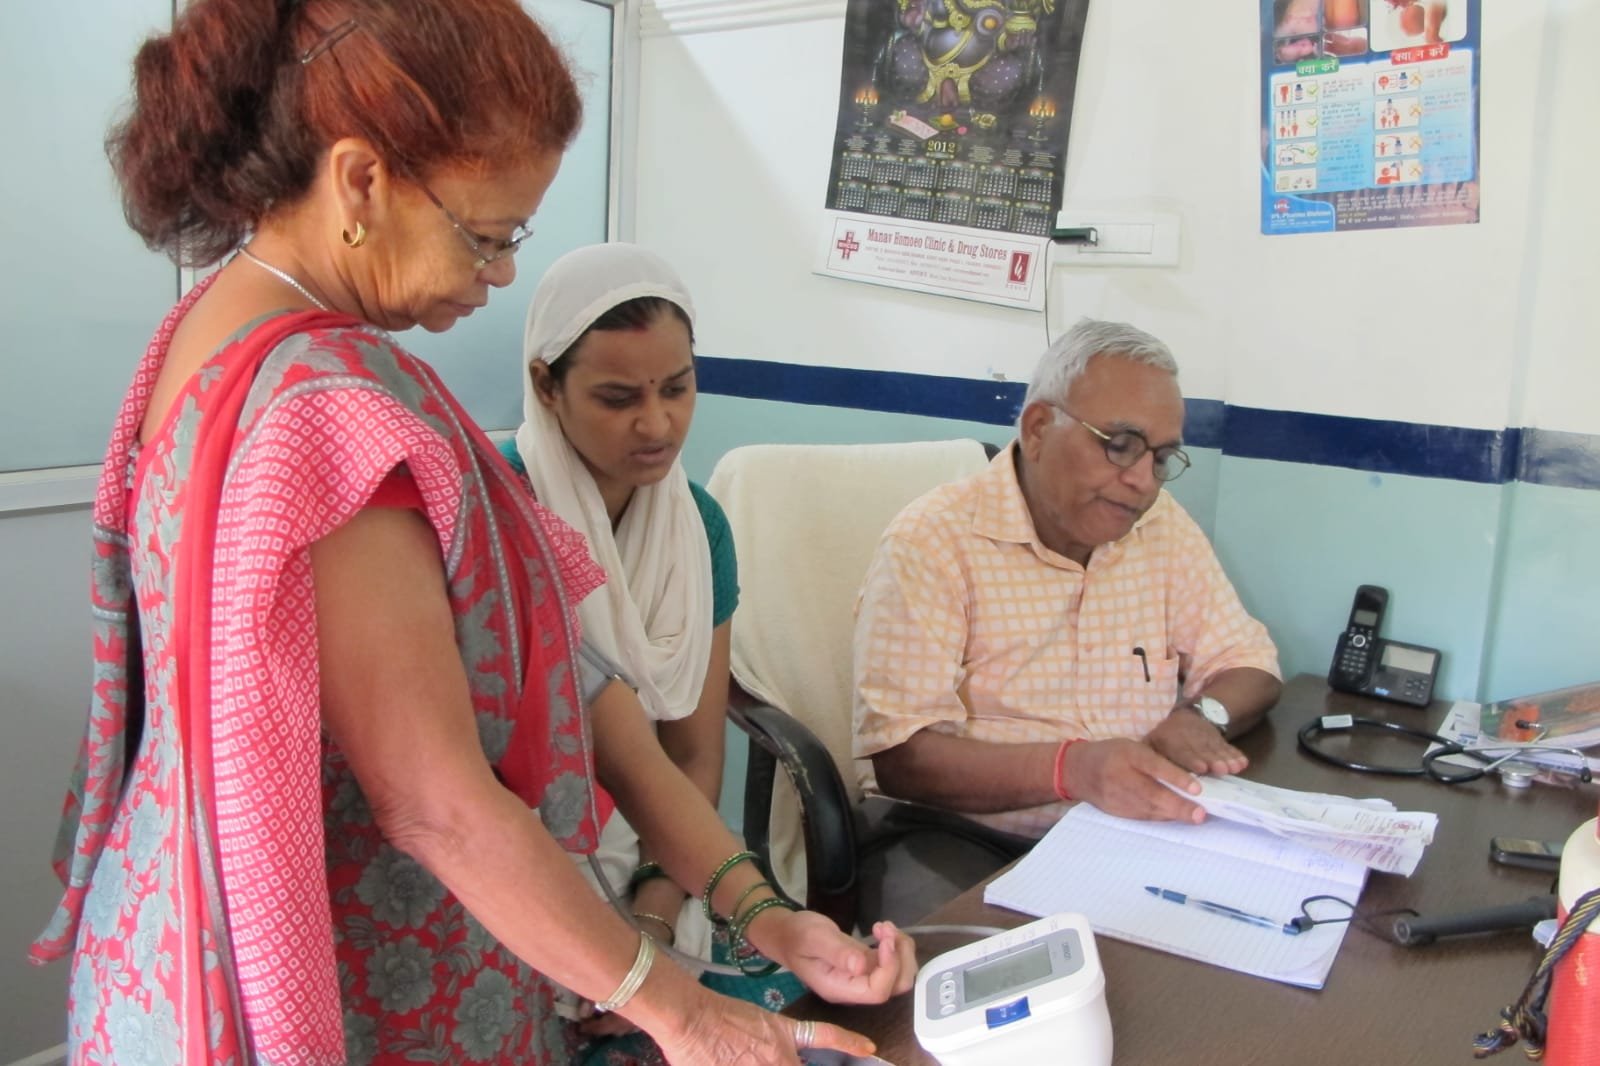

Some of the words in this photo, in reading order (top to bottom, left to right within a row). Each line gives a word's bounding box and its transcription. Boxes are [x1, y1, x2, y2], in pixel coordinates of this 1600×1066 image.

[1395, 50, 1411, 62] क्या
[1416, 50, 1424, 60] न
[1429, 46, 1445, 58] करें
[1298, 63, 1315, 75] क्या
[1321, 59, 1336, 72] करें
[927, 140, 956, 153] 2012
[867, 228, 893, 243] Manav
[893, 231, 923, 248] Homoeo
[924, 235, 946, 252] Clinic
[947, 239, 955, 253] &
[957, 240, 979, 259] Drug
[980, 243, 1008, 261] Stores
